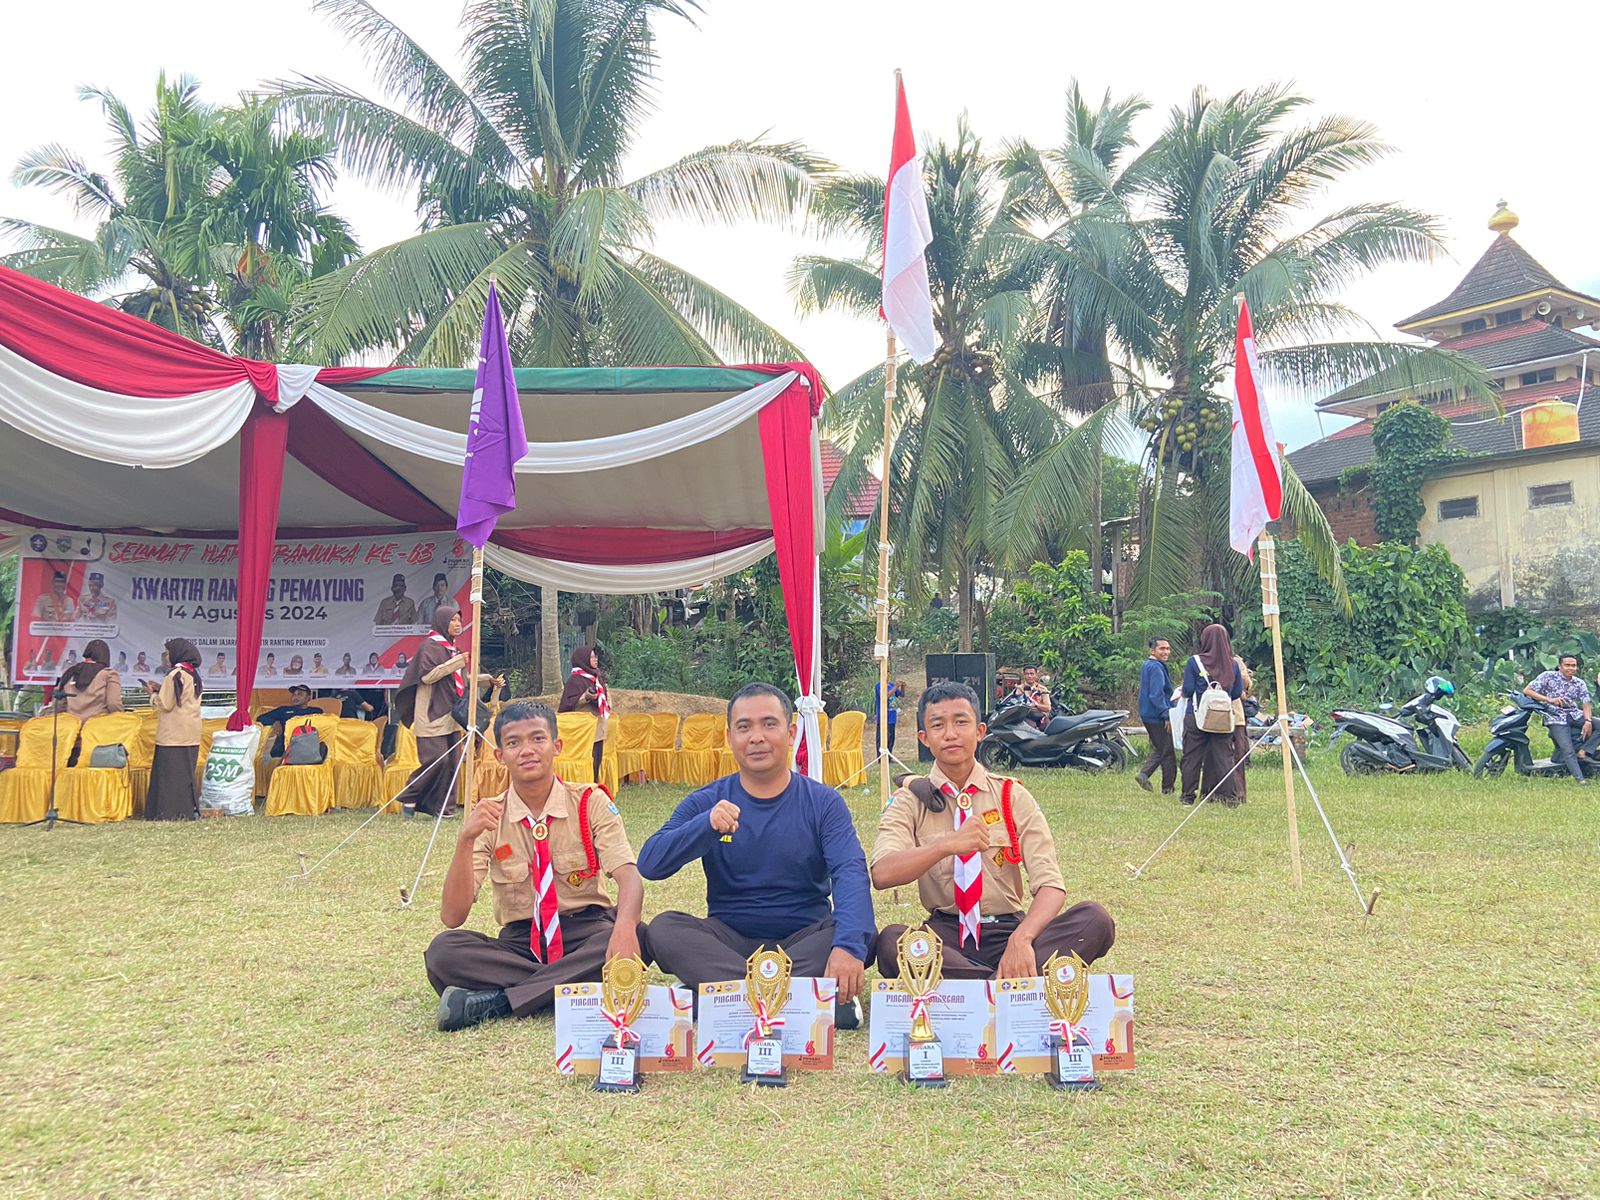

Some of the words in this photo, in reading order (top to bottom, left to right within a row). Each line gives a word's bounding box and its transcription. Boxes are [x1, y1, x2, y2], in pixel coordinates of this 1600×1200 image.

[108, 541, 194, 564] SELAMAT
[273, 542, 361, 565] RAMUKA
[131, 577, 204, 601] KWARTIR
[280, 578, 365, 602] PEMAYUNG
[167, 605, 187, 619] 14
[280, 605, 328, 620] 2024
[269, 639, 295, 647] RANTING
[295, 639, 327, 647] PEMAYUNG
[571, 997, 599, 1007] PIAGAM
[713, 993, 741, 1004] PIAGAM
[1010, 992, 1038, 1003] PIAGAM
[758, 1047, 772, 1056] III
[923, 1051, 929, 1059] I
[611, 1056, 625, 1065] III
[1068, 1054, 1083, 1063] III
